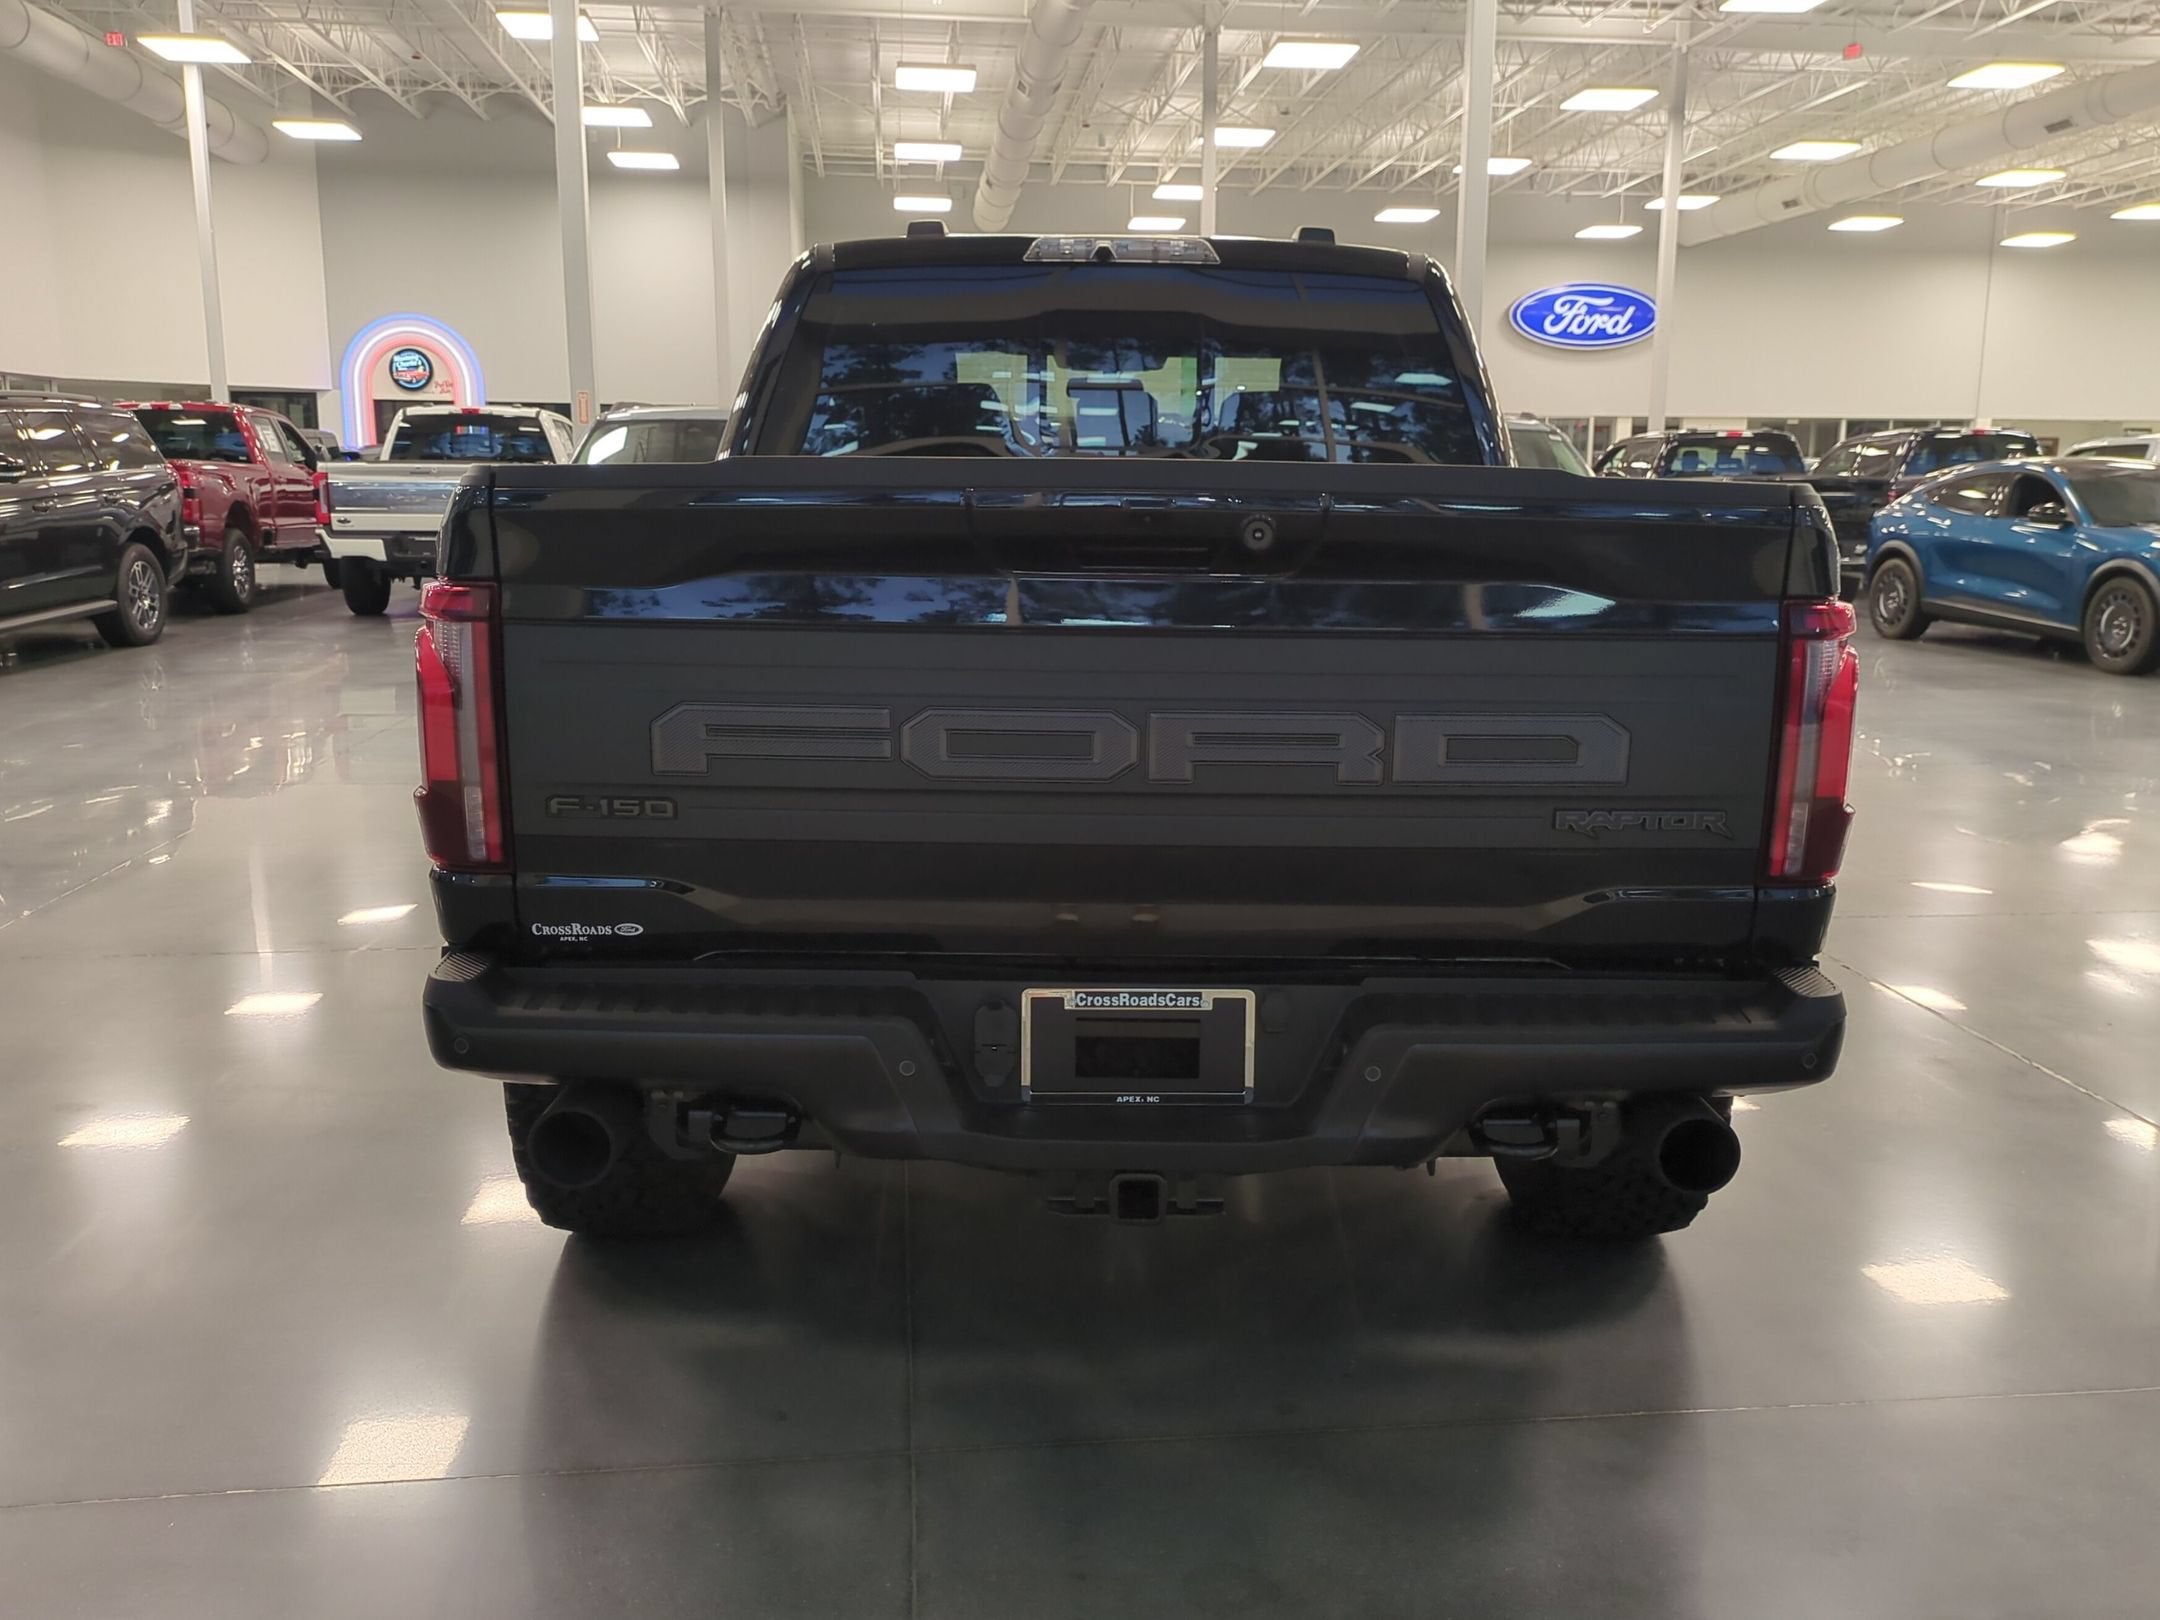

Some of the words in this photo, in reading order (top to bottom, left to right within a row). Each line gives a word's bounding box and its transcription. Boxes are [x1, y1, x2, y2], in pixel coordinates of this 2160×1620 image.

[1543, 294, 1636, 335] Ford
[649, 700, 1632, 787] FORD
[549, 796, 675, 818] F-150
[1553, 809, 1735, 841] RAPTOR
[1076, 992, 1201, 1008] CrossRoadsCars
[1146, 1095, 1160, 1103] NC
